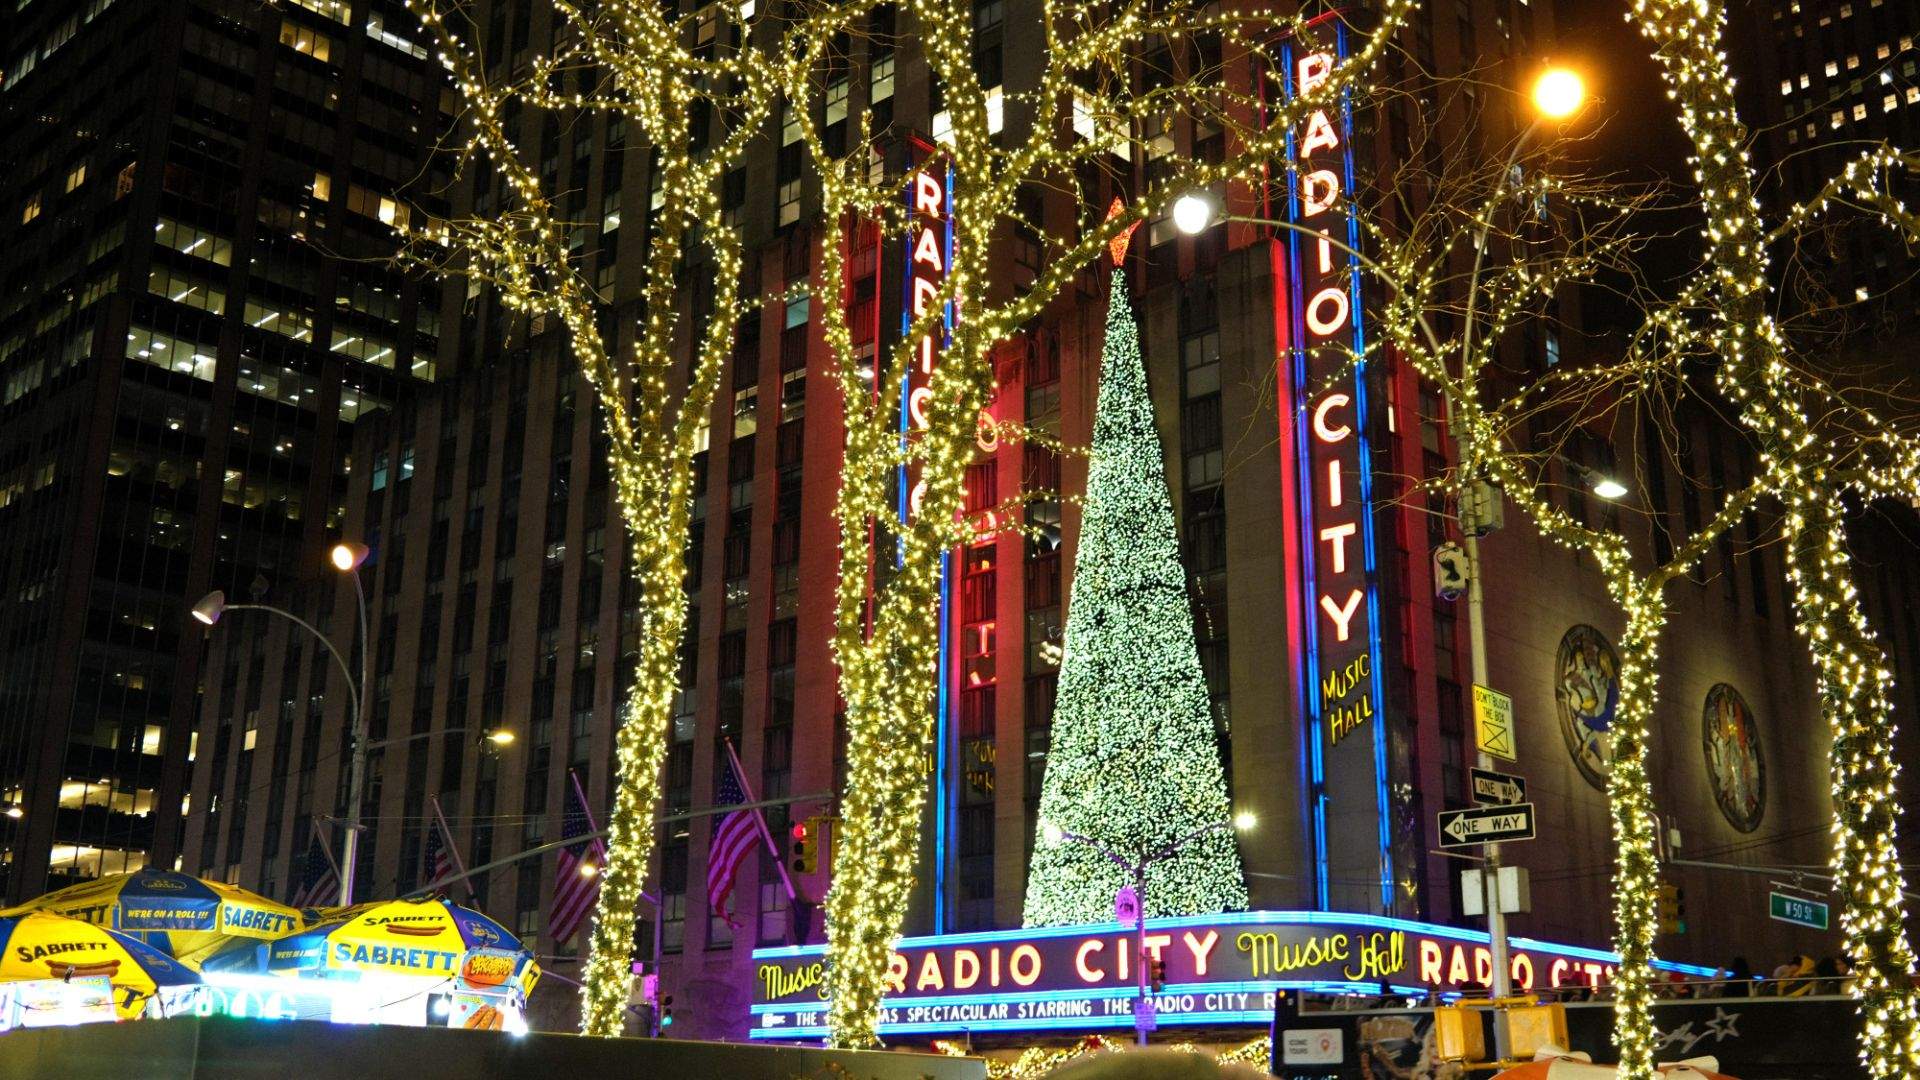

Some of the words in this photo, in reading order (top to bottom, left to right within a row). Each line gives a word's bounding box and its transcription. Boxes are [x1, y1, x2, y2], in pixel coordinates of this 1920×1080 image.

[1298, 51, 1349, 336] RADIO
[1313, 393, 1364, 642] CITY
[1323, 654, 1370, 709] MUSIC
[1331, 695, 1373, 745] HALL
[1479, 780, 1496, 795] ONE
[1501, 784, 1517, 800] WAY
[1453, 819, 1480, 835] ONE
[1491, 815, 1521, 831] WAY
[153, 909, 166, 919] ON
[167, 909, 174, 919] A
[175, 909, 196, 919] ROLL
[224, 905, 297, 932] SABRETT
[363, 916, 446, 926] SABRETT
[1792, 902, 1803, 919] 50
[17, 942, 109, 962] SABRETT
[335, 943, 457, 971] SABRETT
[885, 944, 1042, 993] RADIO
[1075, 930, 1219, 983] CITY
[1237, 932, 1349, 978] Music
[1344, 930, 1408, 982] Hall
[1420, 939, 1534, 993] RADO
[758, 963, 823, 1001] Music
[796, 1012, 818, 1027] THE
[907, 1003, 1008, 1023] SPECTACULAR
[1017, 999, 1092, 1018] STARRING
[1103, 997, 1132, 1016] THE
[1204, 992, 1249, 1012] CITY
